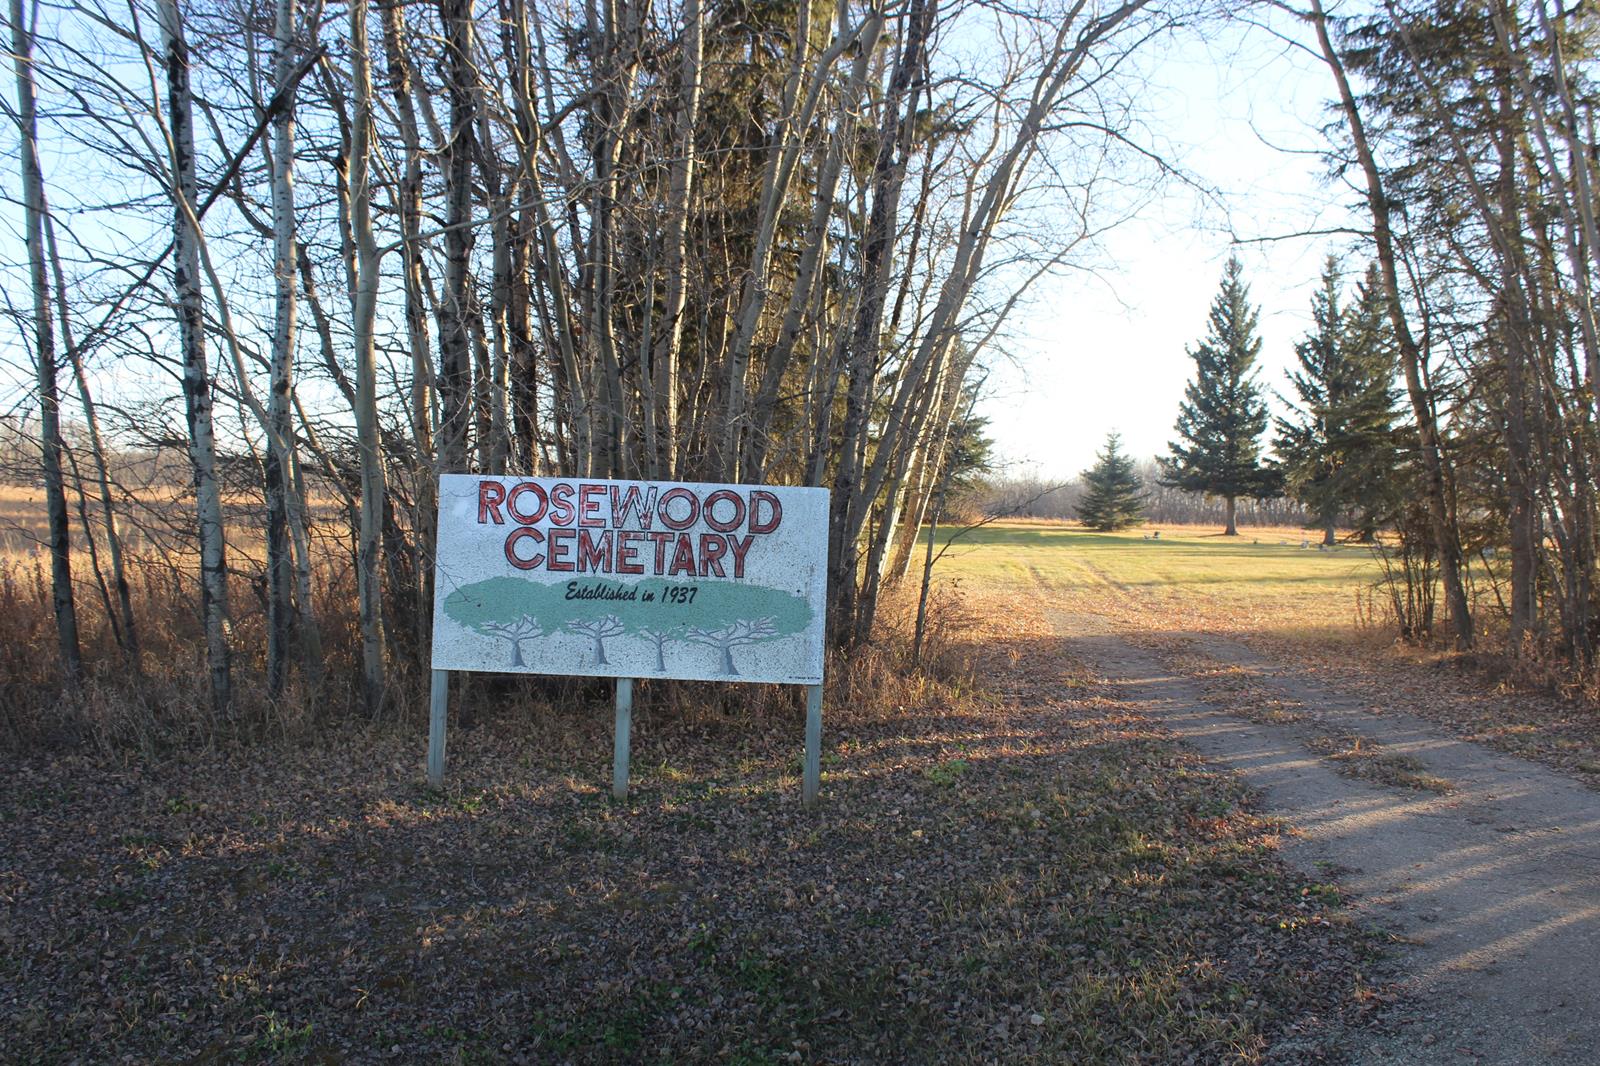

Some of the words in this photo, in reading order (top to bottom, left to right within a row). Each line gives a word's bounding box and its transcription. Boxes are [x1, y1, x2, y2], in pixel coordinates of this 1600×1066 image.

[478, 481, 783, 534] ROSEWOOD
[504, 527, 755, 578] CEMETARY
[565, 581, 638, 602] Established
[642, 589, 655, 602] in
[661, 586, 698, 604] 1937
